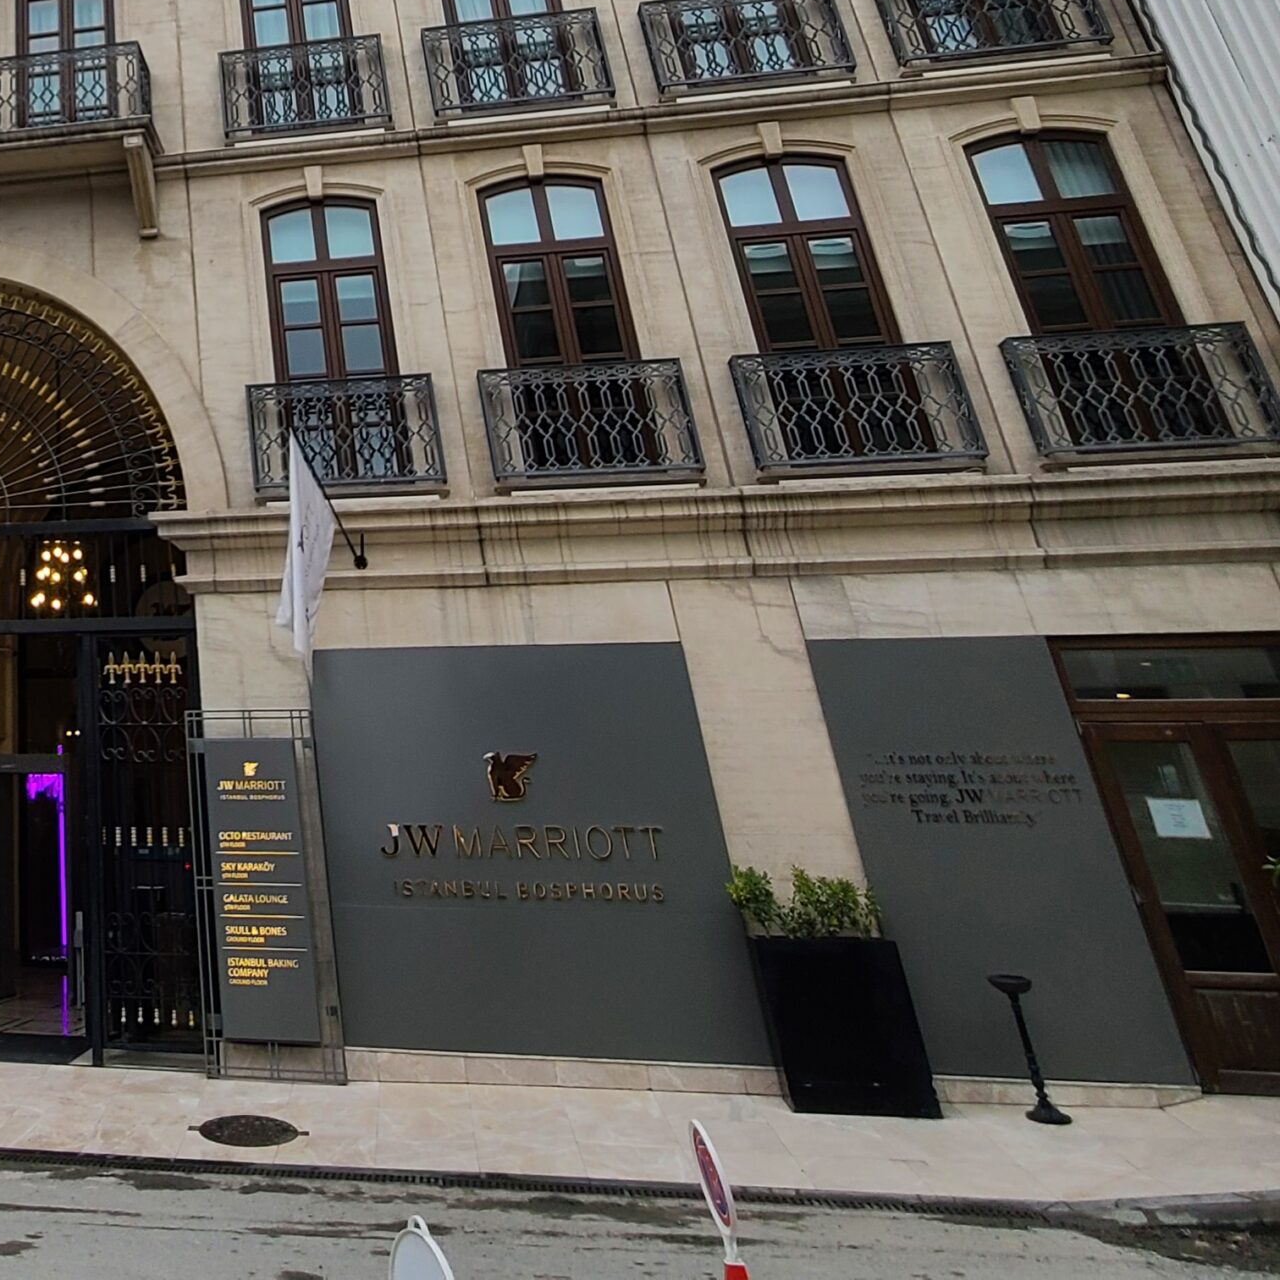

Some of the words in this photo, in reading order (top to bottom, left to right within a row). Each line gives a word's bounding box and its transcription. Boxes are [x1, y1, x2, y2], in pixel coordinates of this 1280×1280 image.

[909, 754, 932, 765] not
[217, 780, 234, 790] JW
[235, 780, 286, 790] MARRIOTT
[956, 789, 983, 803] JW
[219, 831, 240, 840] OCTO
[241, 832, 293, 840] RESTAURANT
[380, 823, 442, 857] JW
[452, 824, 664, 860] MARRIOTT
[221, 862, 236, 871] SKY
[237, 861, 275, 871] KARAKÖY
[393, 879, 508, 899] ISTANBUL
[516, 881, 665, 902] BOSPHORUS
[255, 895, 288, 904] LOUNGE
[225, 926, 251, 935] SKULL
[260, 927, 287, 936] BONES
[227, 958, 267, 967] ISTANBUL
[268, 959, 299, 969] BAKING
[228, 968, 269, 978] COMPANY
